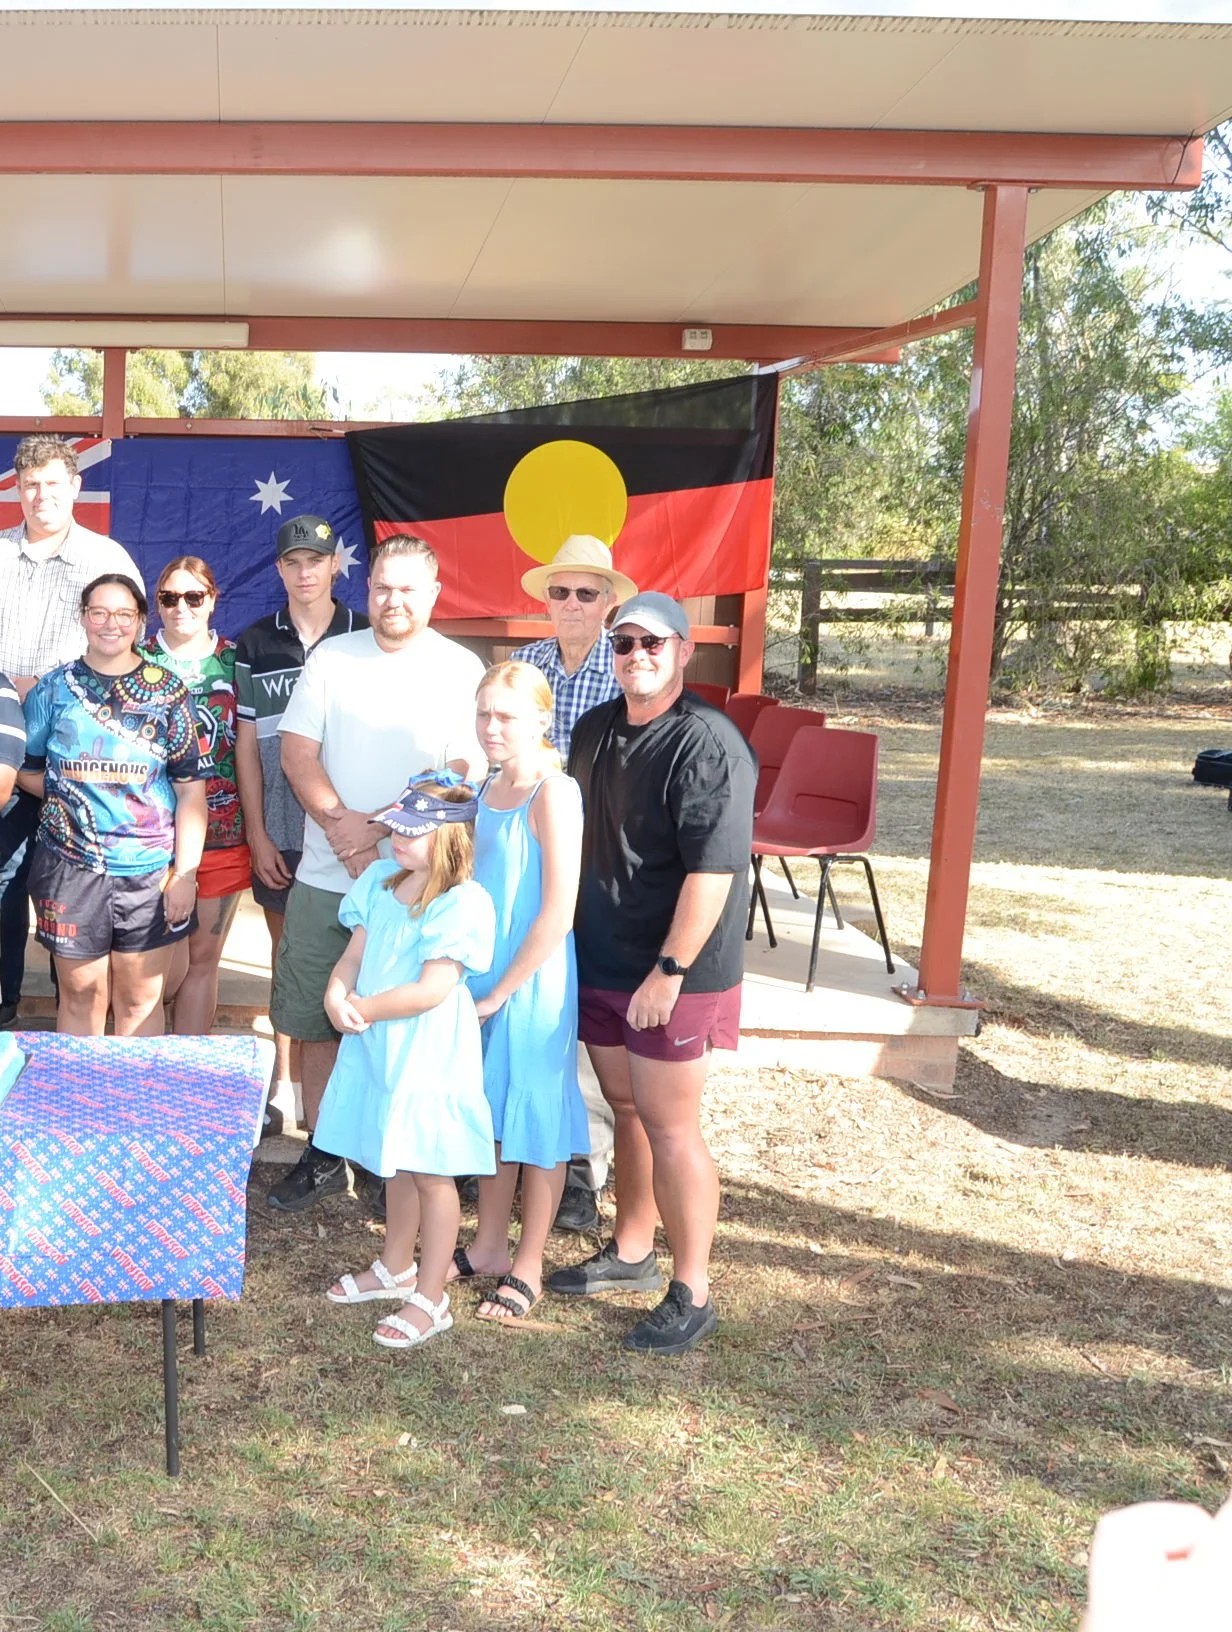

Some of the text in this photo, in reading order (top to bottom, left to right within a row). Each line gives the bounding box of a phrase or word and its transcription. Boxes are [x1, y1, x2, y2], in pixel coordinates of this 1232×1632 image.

[59, 759, 148, 784] INDIGENOUS
[383, 818, 439, 837] AUSTRALIA
[10, 1140, 51, 1184] AUSTRALIA
[127, 1141, 171, 1182] AUSTRALIA
[95, 1170, 136, 1209] AUSTRALIA
[61, 1200, 102, 1237] AUSTRALIA
[181, 1192, 225, 1236] AUSTRALIA
[25, 1226, 68, 1265] AUSTRALIA
[144, 1218, 189, 1260] AUSTRALIA
[110, 1247, 155, 1292] AUSTRALIA
